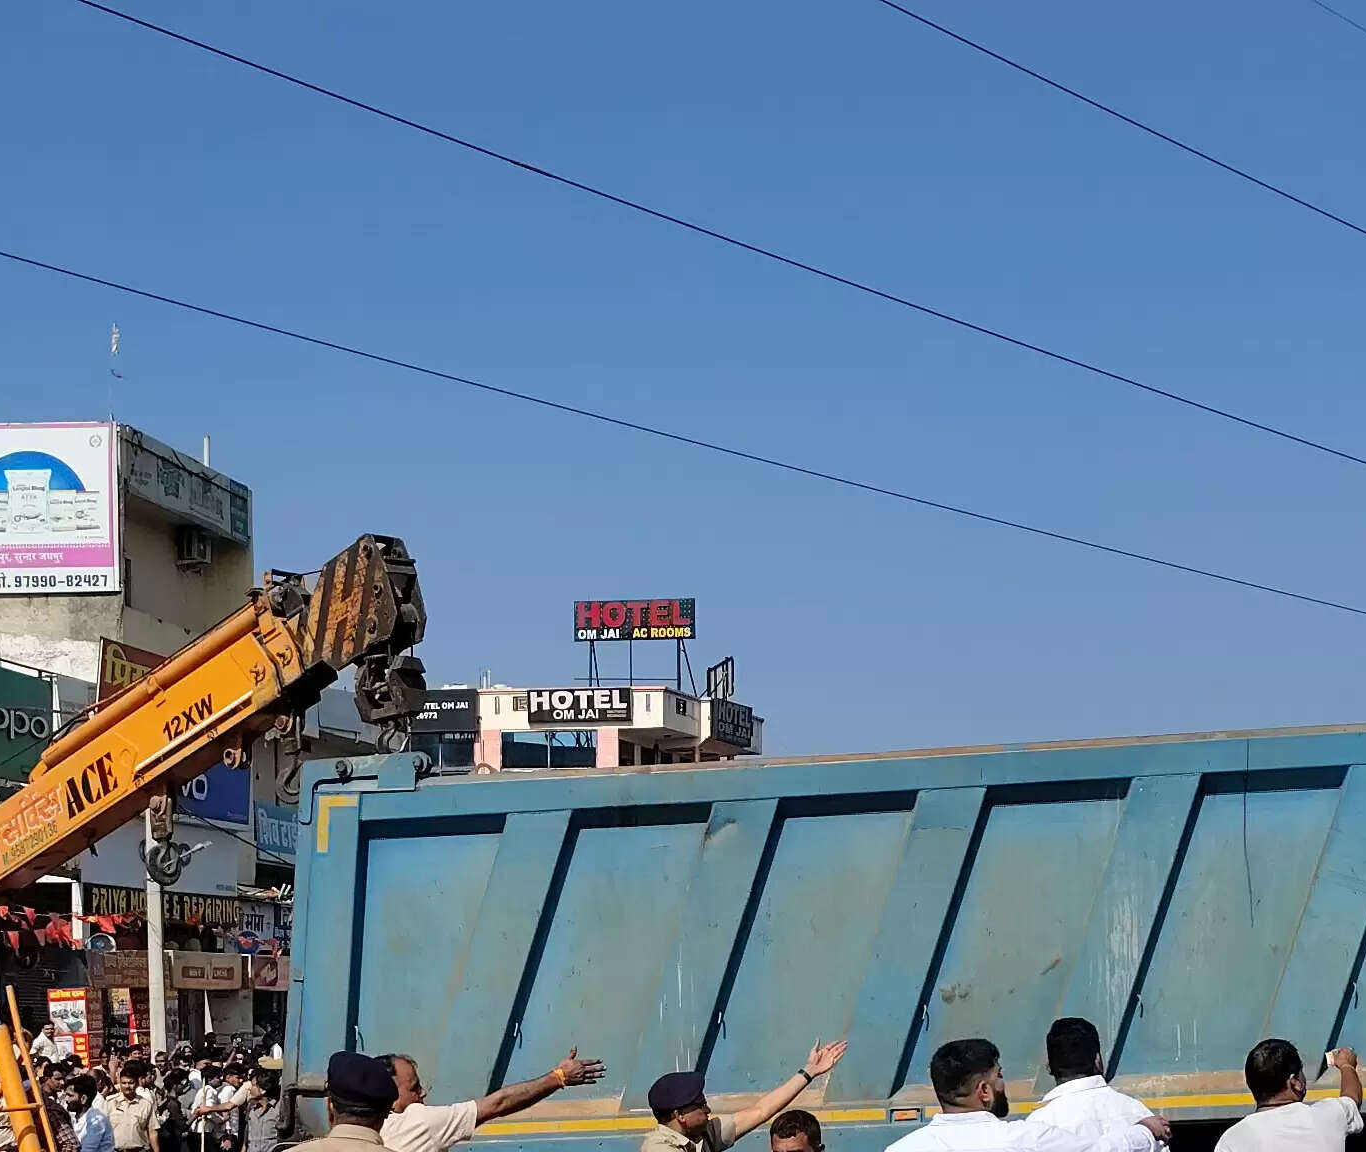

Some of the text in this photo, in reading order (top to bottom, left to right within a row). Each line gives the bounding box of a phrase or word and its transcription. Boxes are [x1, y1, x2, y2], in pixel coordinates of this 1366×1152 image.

[14, 574, 108, 588] 97990-82427
[575, 600, 691, 629] HOTEL
[578, 627, 691, 640] OM JAI AC ROOMS
[530, 690, 627, 713] HOTEL
[553, 709, 575, 720] OM
[578, 709, 599, 719] JAI
[718, 700, 753, 728] HOTEL
[163, 693, 213, 741] 12XW
[63, 752, 119, 820] ACE
[92, 887, 126, 914] PRIYA
[183, 895, 240, 924] REPAIRING
